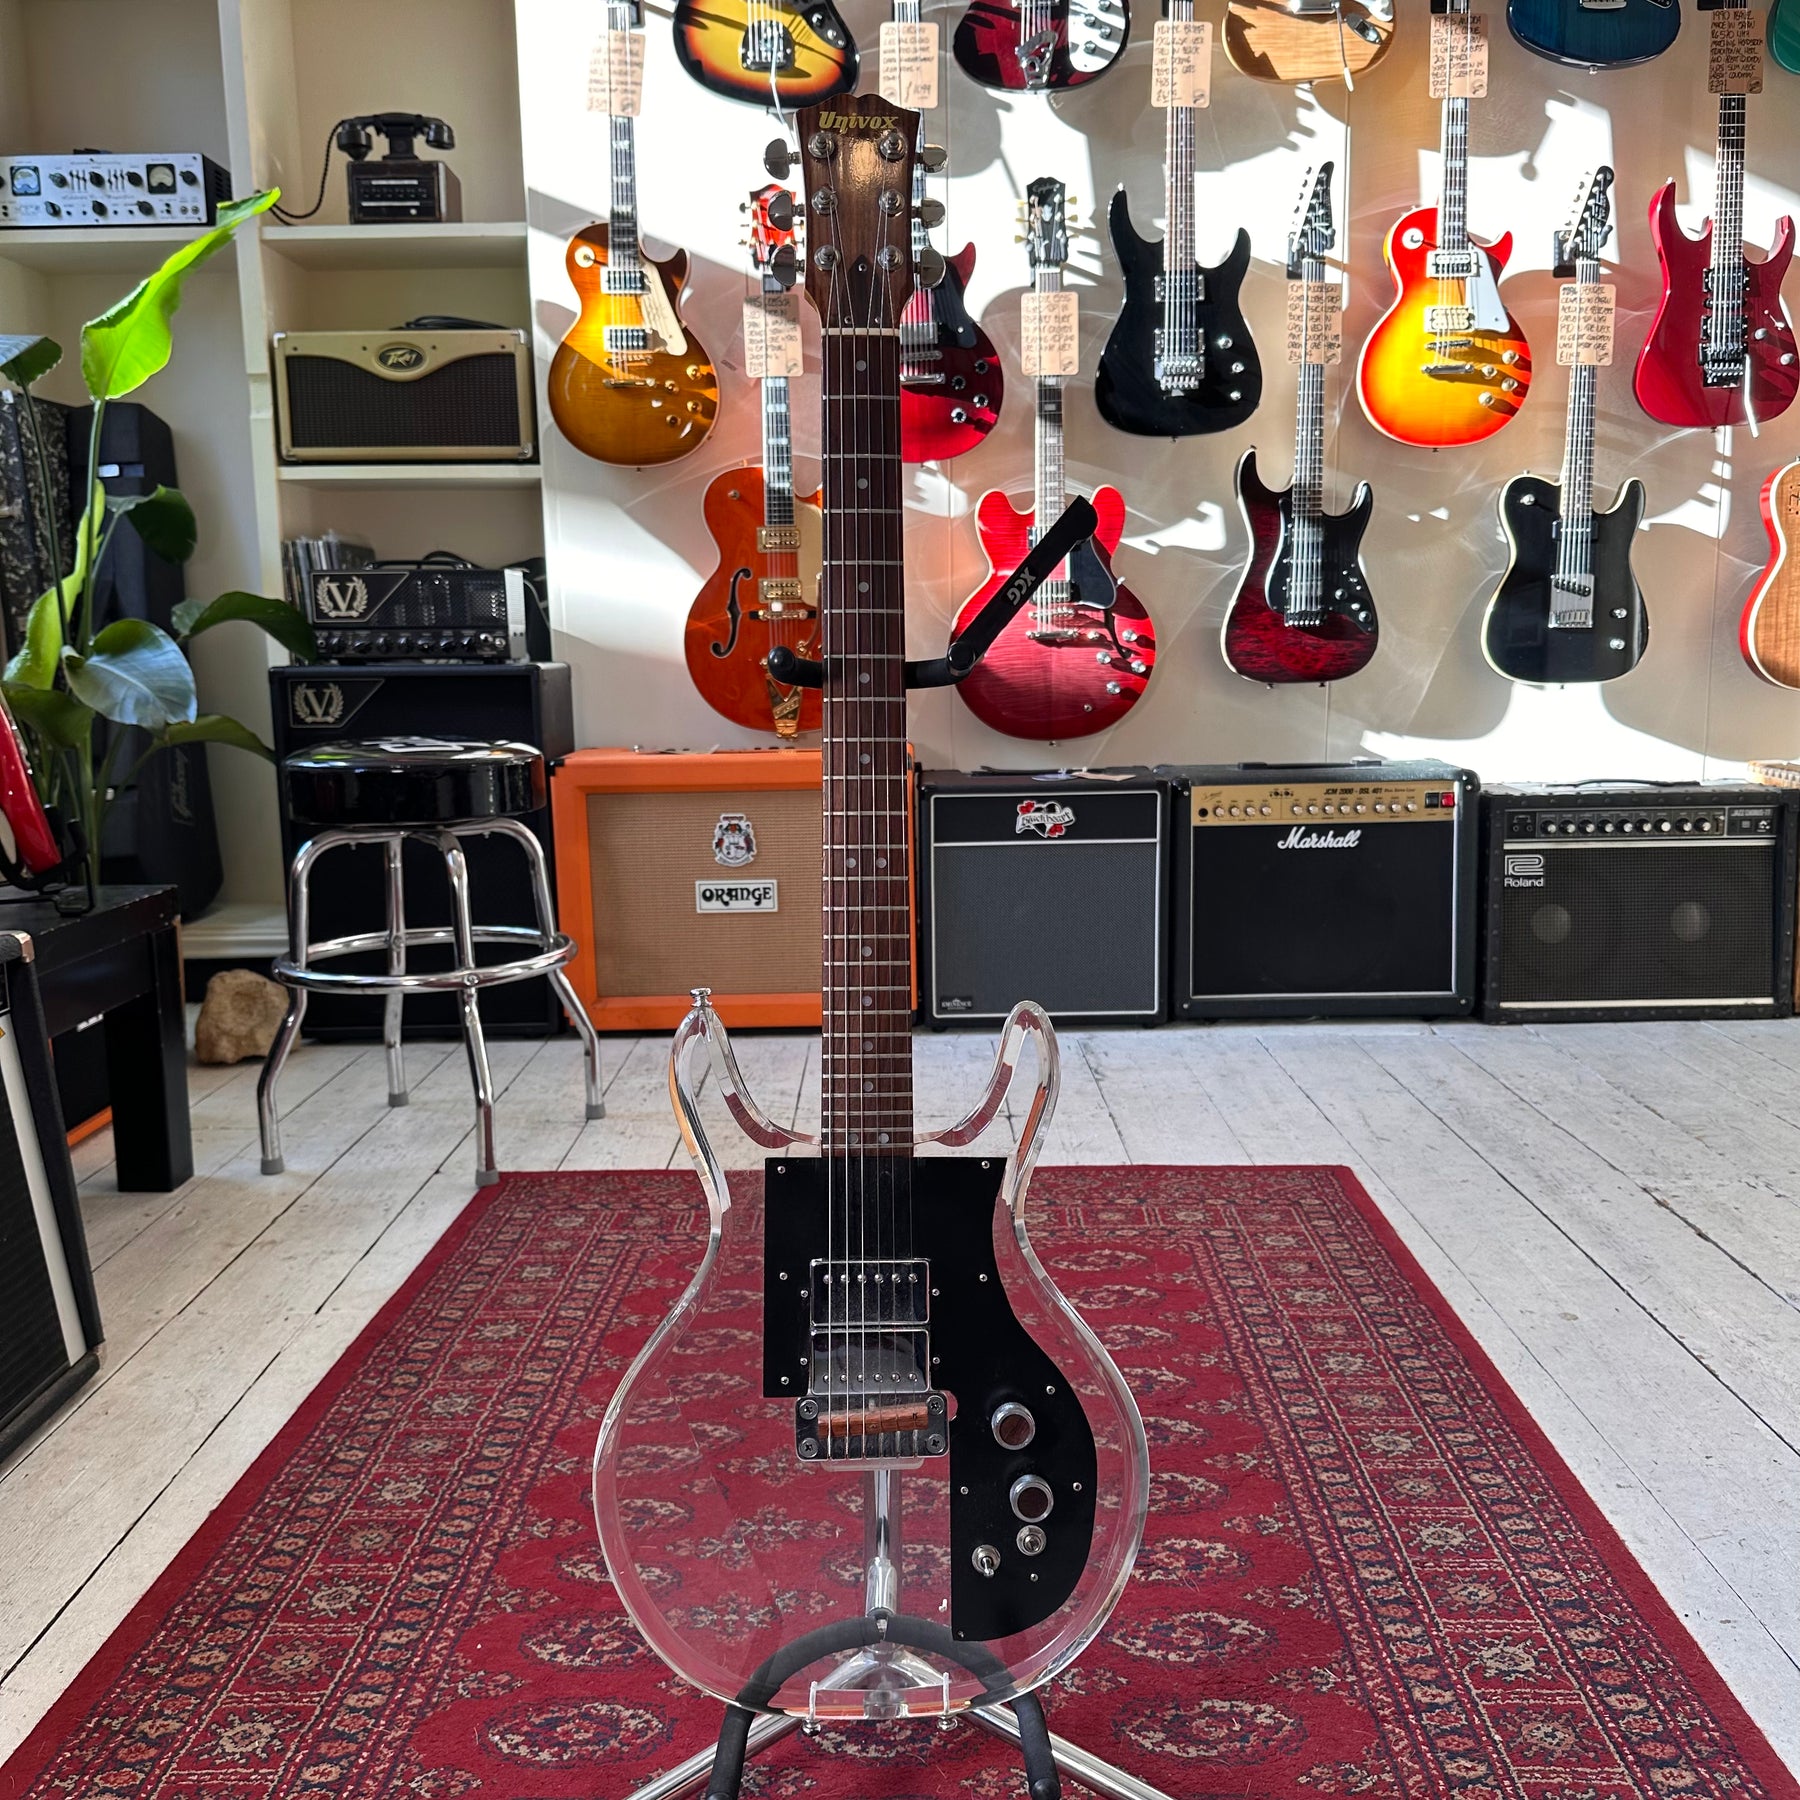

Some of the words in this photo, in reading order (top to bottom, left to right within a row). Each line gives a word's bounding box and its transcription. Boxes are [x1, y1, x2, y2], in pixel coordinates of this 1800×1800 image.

[819, 111, 899, 134] Univox
[1006, 567, 1036, 606] XCG
[1277, 831, 1363, 855] Marshall
[1504, 877, 1544, 887] Roland
[702, 887, 772, 906] ORANGE
